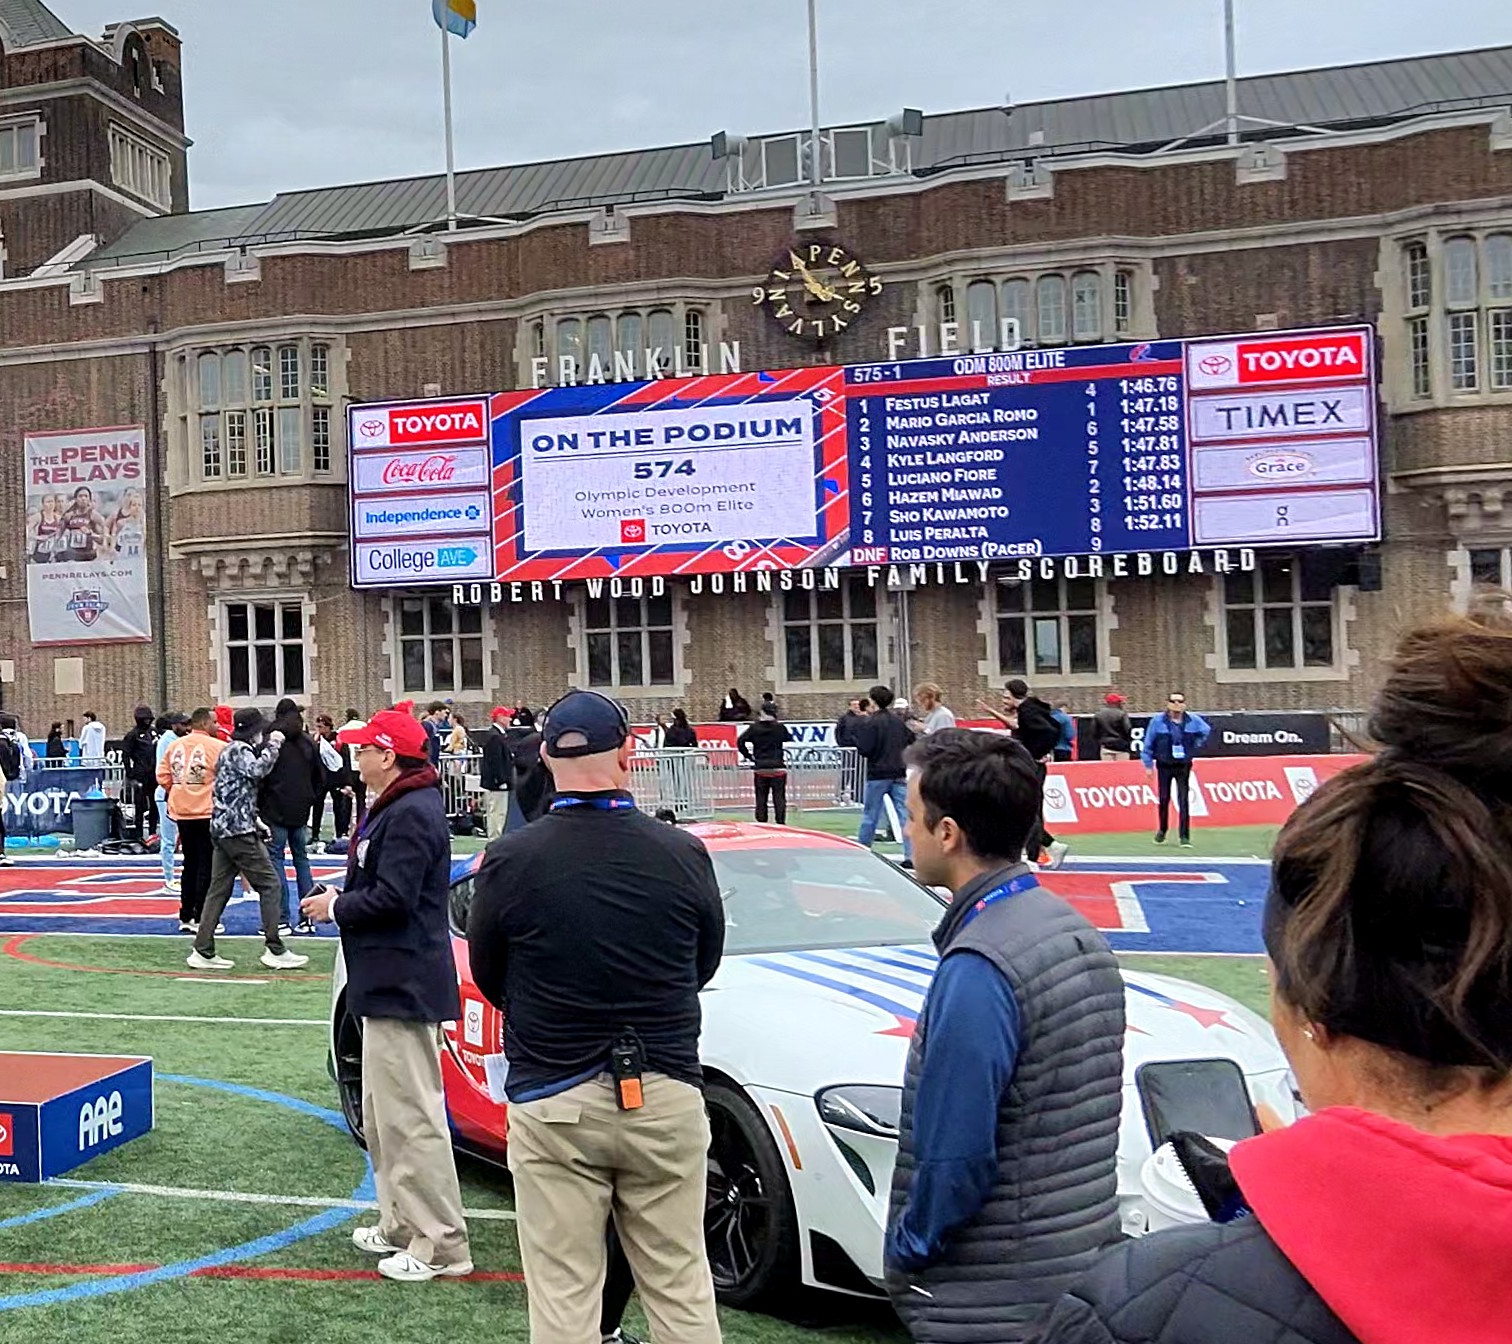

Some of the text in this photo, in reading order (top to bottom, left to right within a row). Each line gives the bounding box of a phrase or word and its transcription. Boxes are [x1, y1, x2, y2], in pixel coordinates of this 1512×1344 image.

[531, 317, 1021, 389] FRANKLIN FIELD
[953, 351, 1066, 375] ODM 800M ELITE
[1242, 346, 1357, 372] TOYOTA
[987, 373, 1031, 387] RESULT
[859, 399, 868, 414] 1
[1085, 383, 1097, 397] 4
[1119, 377, 1178, 394] 1:46.76
[392, 412, 479, 435] TOYOTA
[859, 418, 871, 433] 2
[1087, 402, 1096, 417] 1
[1120, 396, 1178, 414] 1:47.18
[1215, 399, 1344, 430] TIMEX
[532, 417, 802, 452] ON THE PODIUM
[859, 436, 871, 451] 3
[1086, 421, 1098, 436] 6
[1121, 416, 1179, 433] 1:47.58
[30, 442, 140, 466] THE PENN
[860, 455, 871, 469] 4
[1088, 441, 1099, 455] 5
[1121, 435, 1179, 453] 1:47.81
[32, 462, 141, 485] RELAYS
[633, 459, 696, 479] 574
[861, 474, 872, 488] 5
[1088, 460, 1099, 475] 7
[1122, 455, 1181, 472] 1:47.83
[1255, 462, 1305, 473] Grace
[574, 482, 756, 504] Olympic Development
[861, 492, 873, 507] 6
[1089, 479, 1100, 494] 2
[1123, 474, 1182, 492] 1:48.14
[365, 507, 462, 525] Independence
[581, 499, 754, 519] Women's 800m Elite
[862, 511, 873, 525] 7
[1089, 498, 1101, 513] 3
[1123, 494, 1182, 511] 1:51.60
[652, 522, 712, 536] TOYOTA
[863, 529, 874, 544] 8
[1090, 518, 1102, 533] 8
[1124, 513, 1182, 531] 1:52.11
[369, 548, 468, 572] College AVE
[853, 547, 887, 563] DNF
[1090, 537, 1102, 552] 9
[42, 570, 133, 580] PENNRELAYS.COM
[453, 548, 1256, 605] ROBERT WOOD JOHNSON FAMILY SCOREBOARD
[1223, 730, 1303, 744] Dream On.
[1074, 784, 1160, 808] TOYOTA
[1204, 780, 1282, 803] TOYOTA
